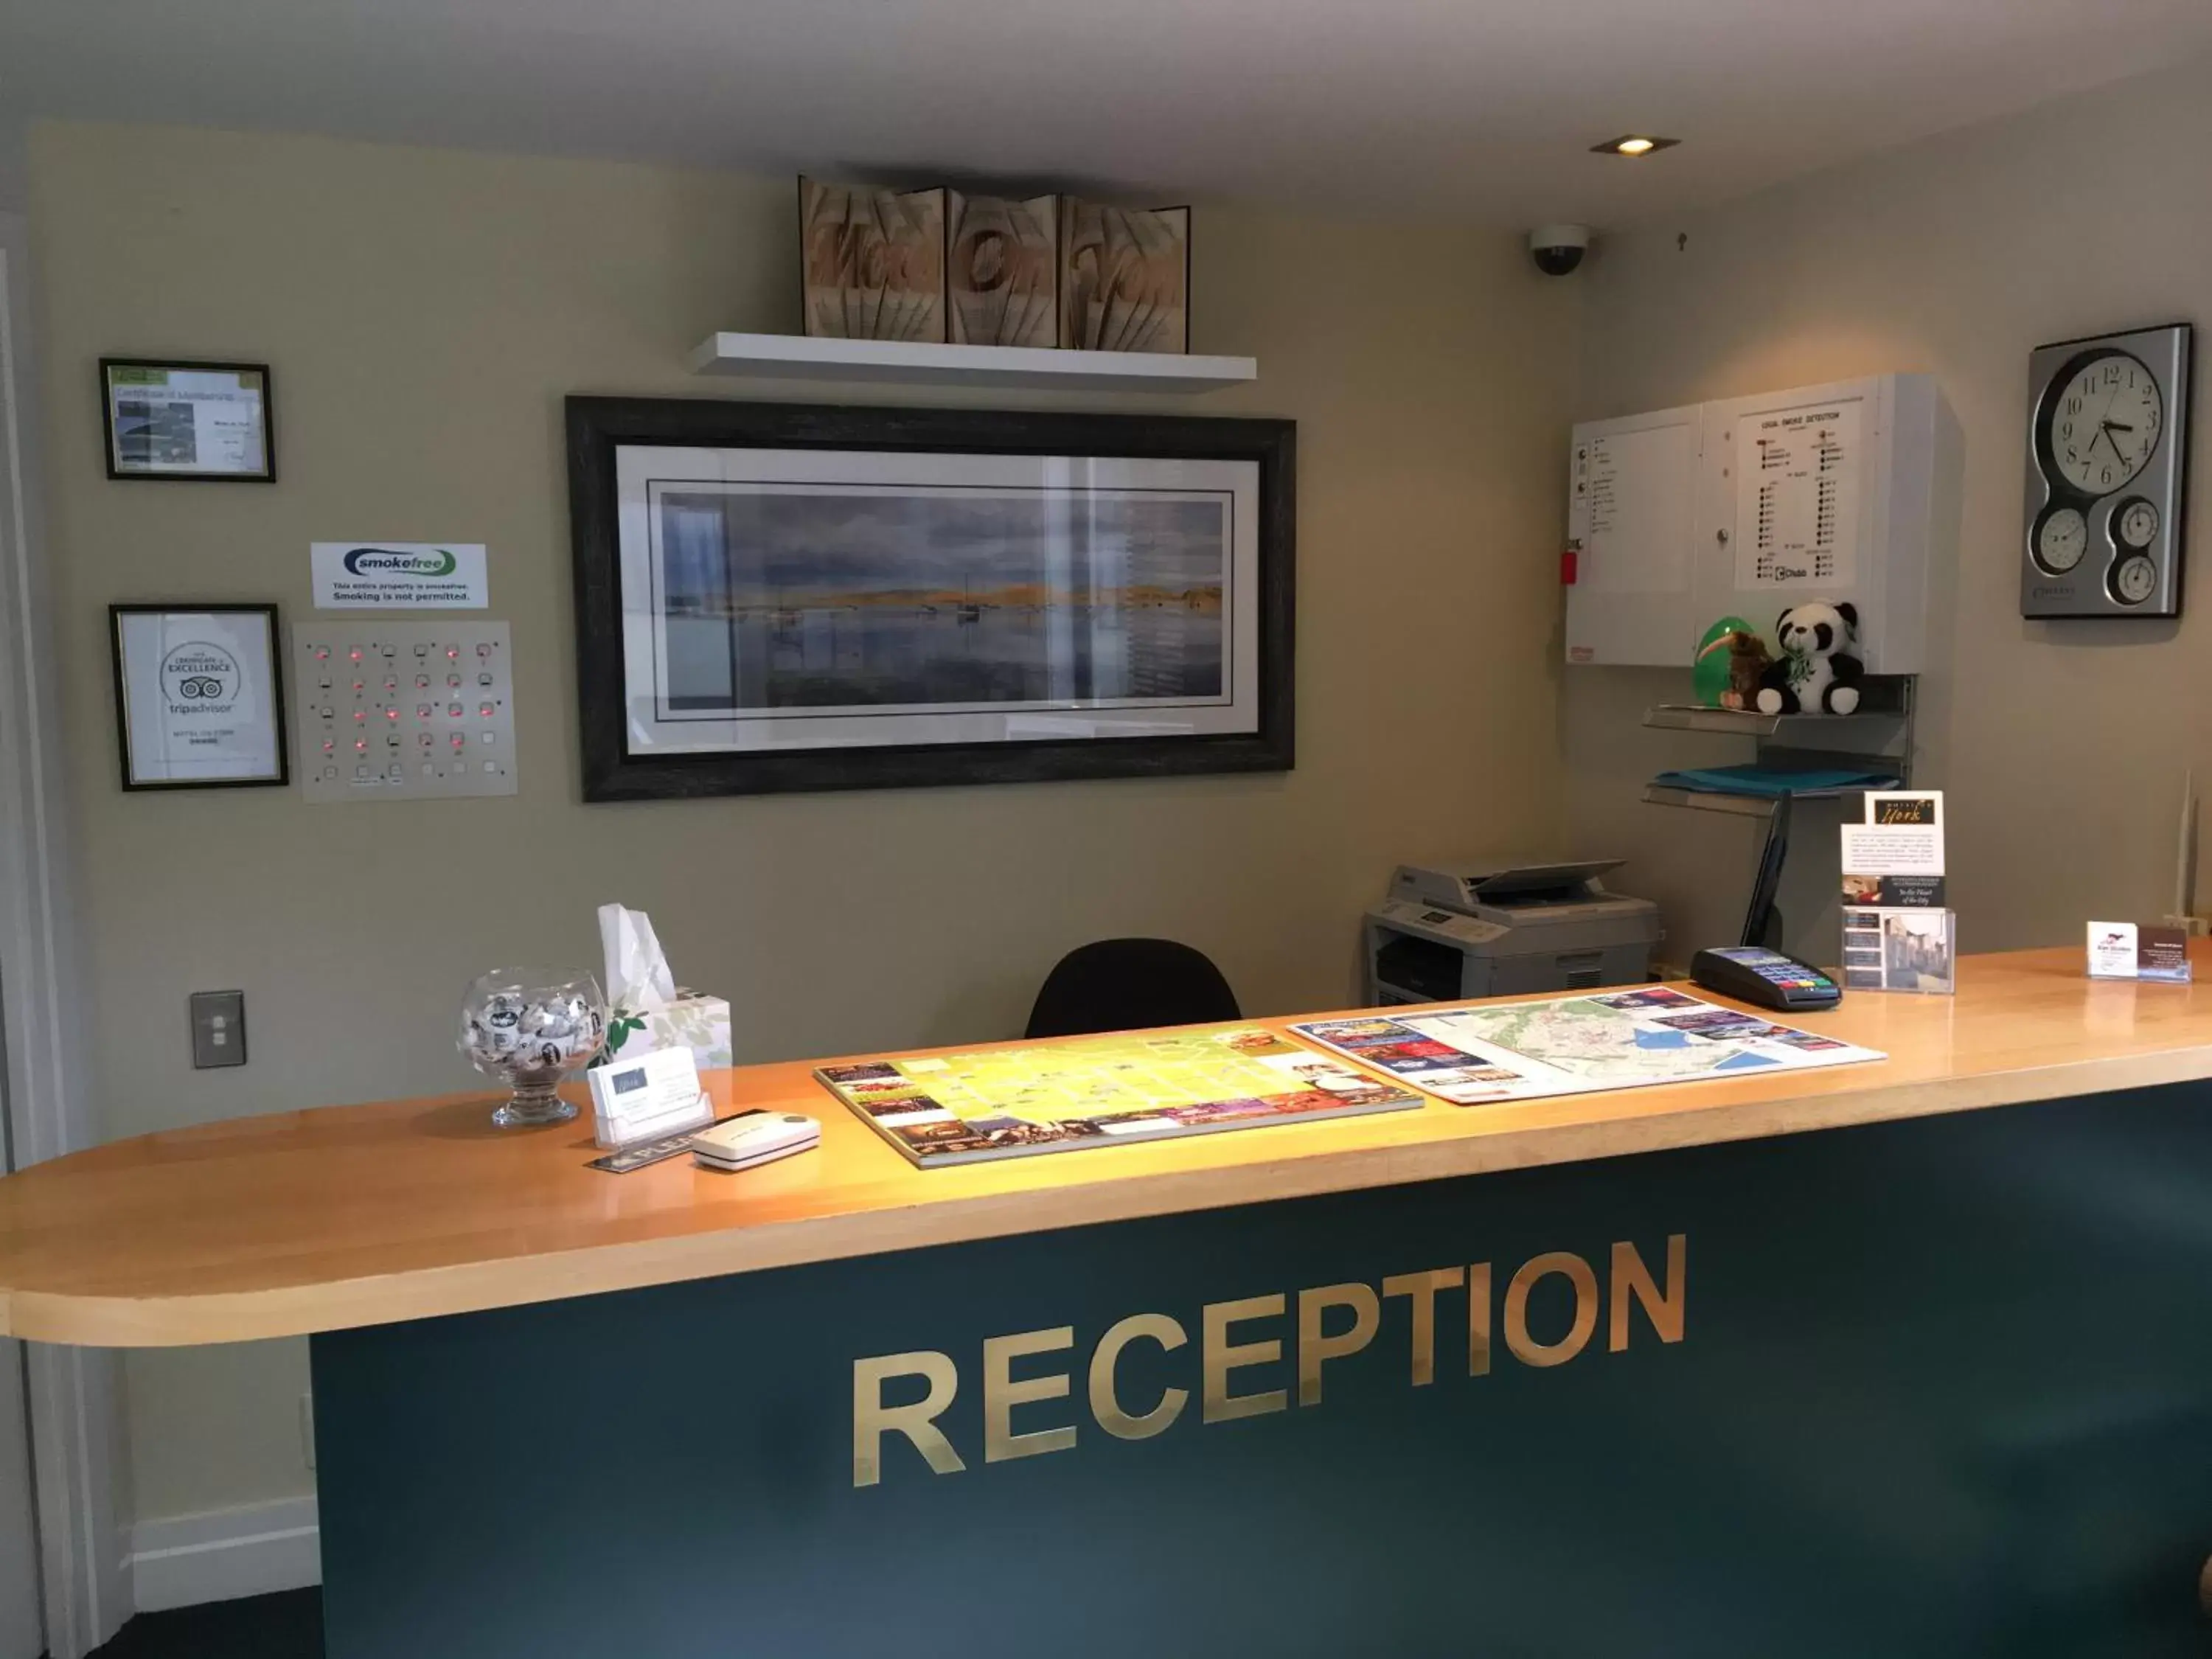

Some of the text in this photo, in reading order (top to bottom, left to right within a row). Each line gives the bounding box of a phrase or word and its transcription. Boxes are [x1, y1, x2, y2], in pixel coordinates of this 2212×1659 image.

[2104, 366, 2119, 385] 12
[2129, 370, 2134, 389] 1
[2084, 376, 2096, 396] 11
[2141, 384, 2153, 405] 2
[2067, 397, 2083, 416] 10
[2146, 410, 2157, 431] 3
[2062, 422, 2073, 441] 9
[2066, 445, 2078, 465] 8
[2139, 437, 2149, 456] 4
[2081, 462, 2092, 481] 7
[2101, 463, 2111, 484] 6
[2123, 456, 2132, 476] 5
[359, 557, 442, 569] smokefree
[333, 592, 470, 602] Smoking is not permitted.
[168, 664, 231, 673] EXCELLENCE
[170, 703, 231, 715] tripadvisor
[852, 1234, 1687, 1488] RECEPTION
